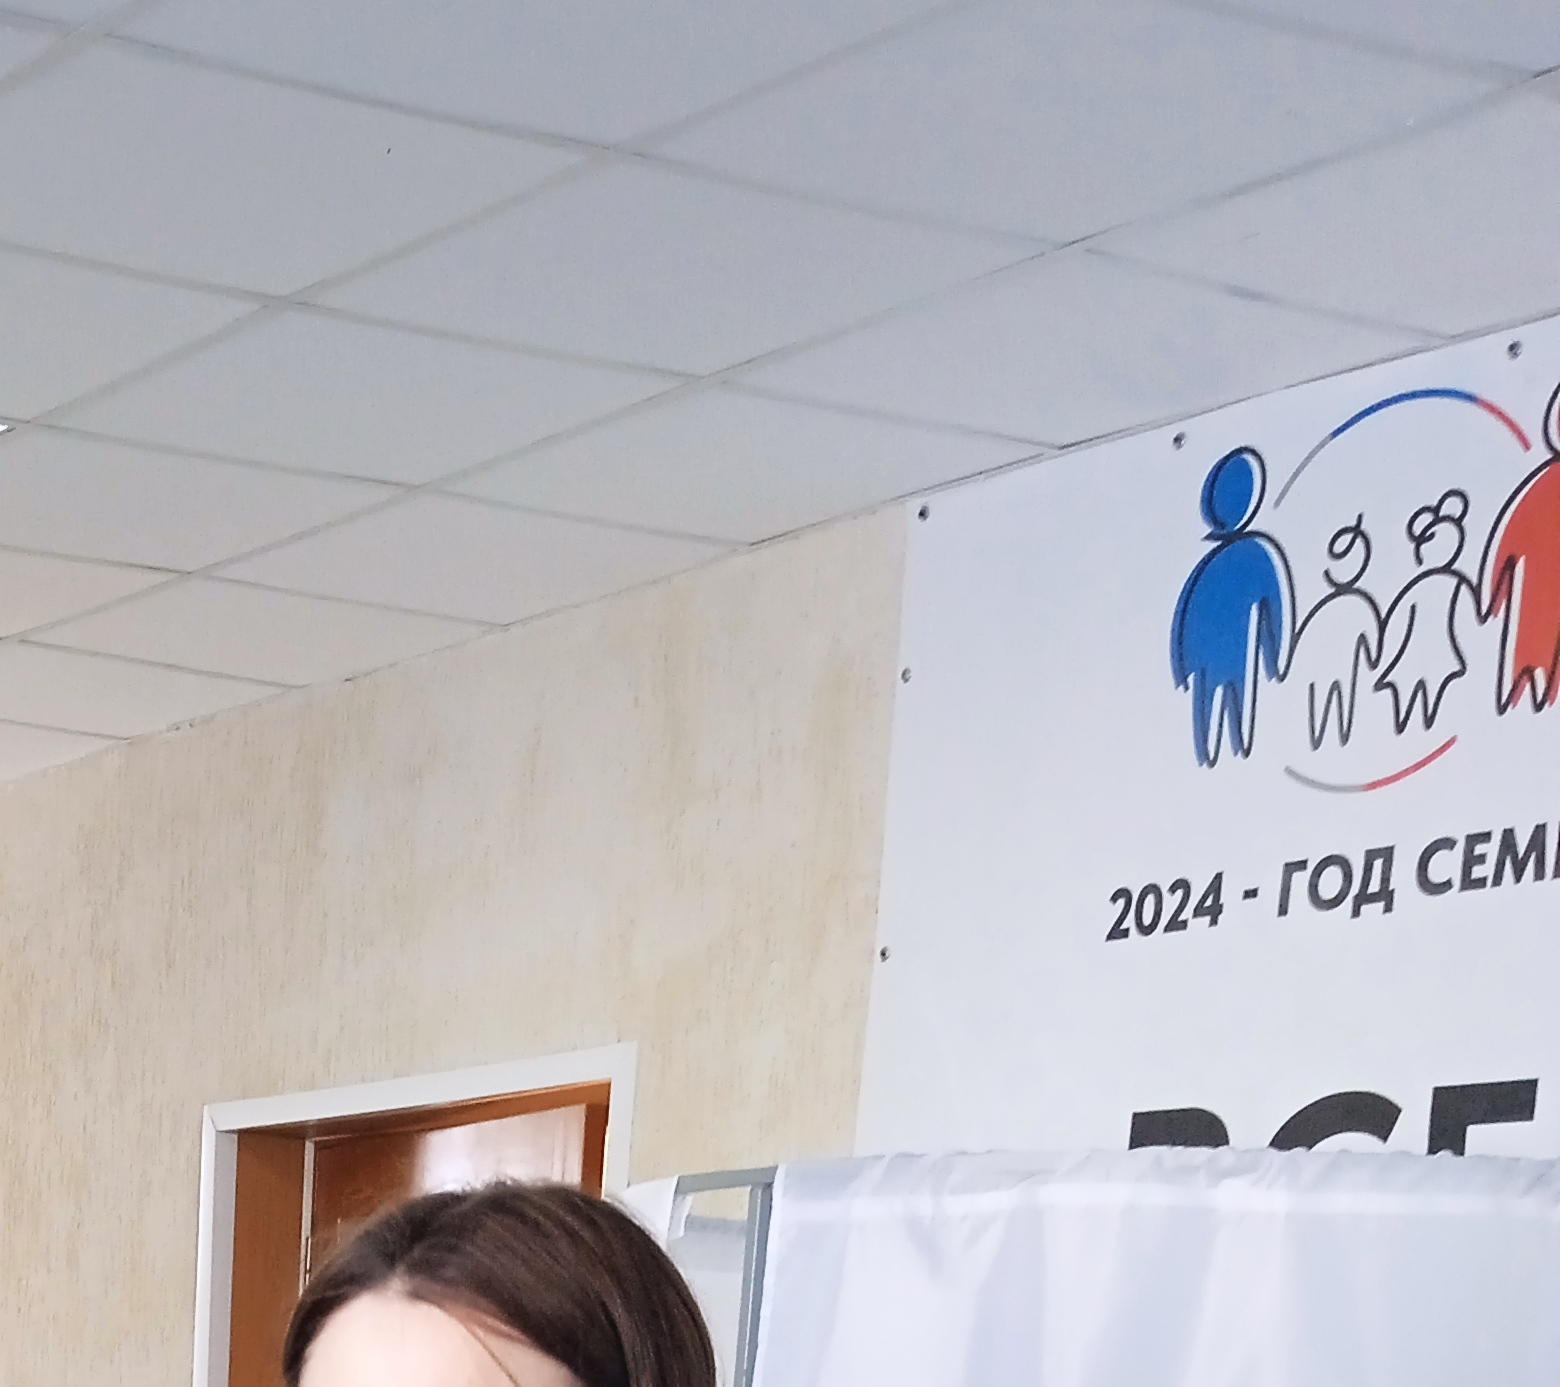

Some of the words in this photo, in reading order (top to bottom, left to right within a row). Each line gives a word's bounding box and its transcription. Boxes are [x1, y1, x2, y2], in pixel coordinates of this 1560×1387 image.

[1105, 870, 1224, 942] 2024
[1277, 844, 1397, 920] ГОД
[1415, 821, 1560, 897] СЕМ
